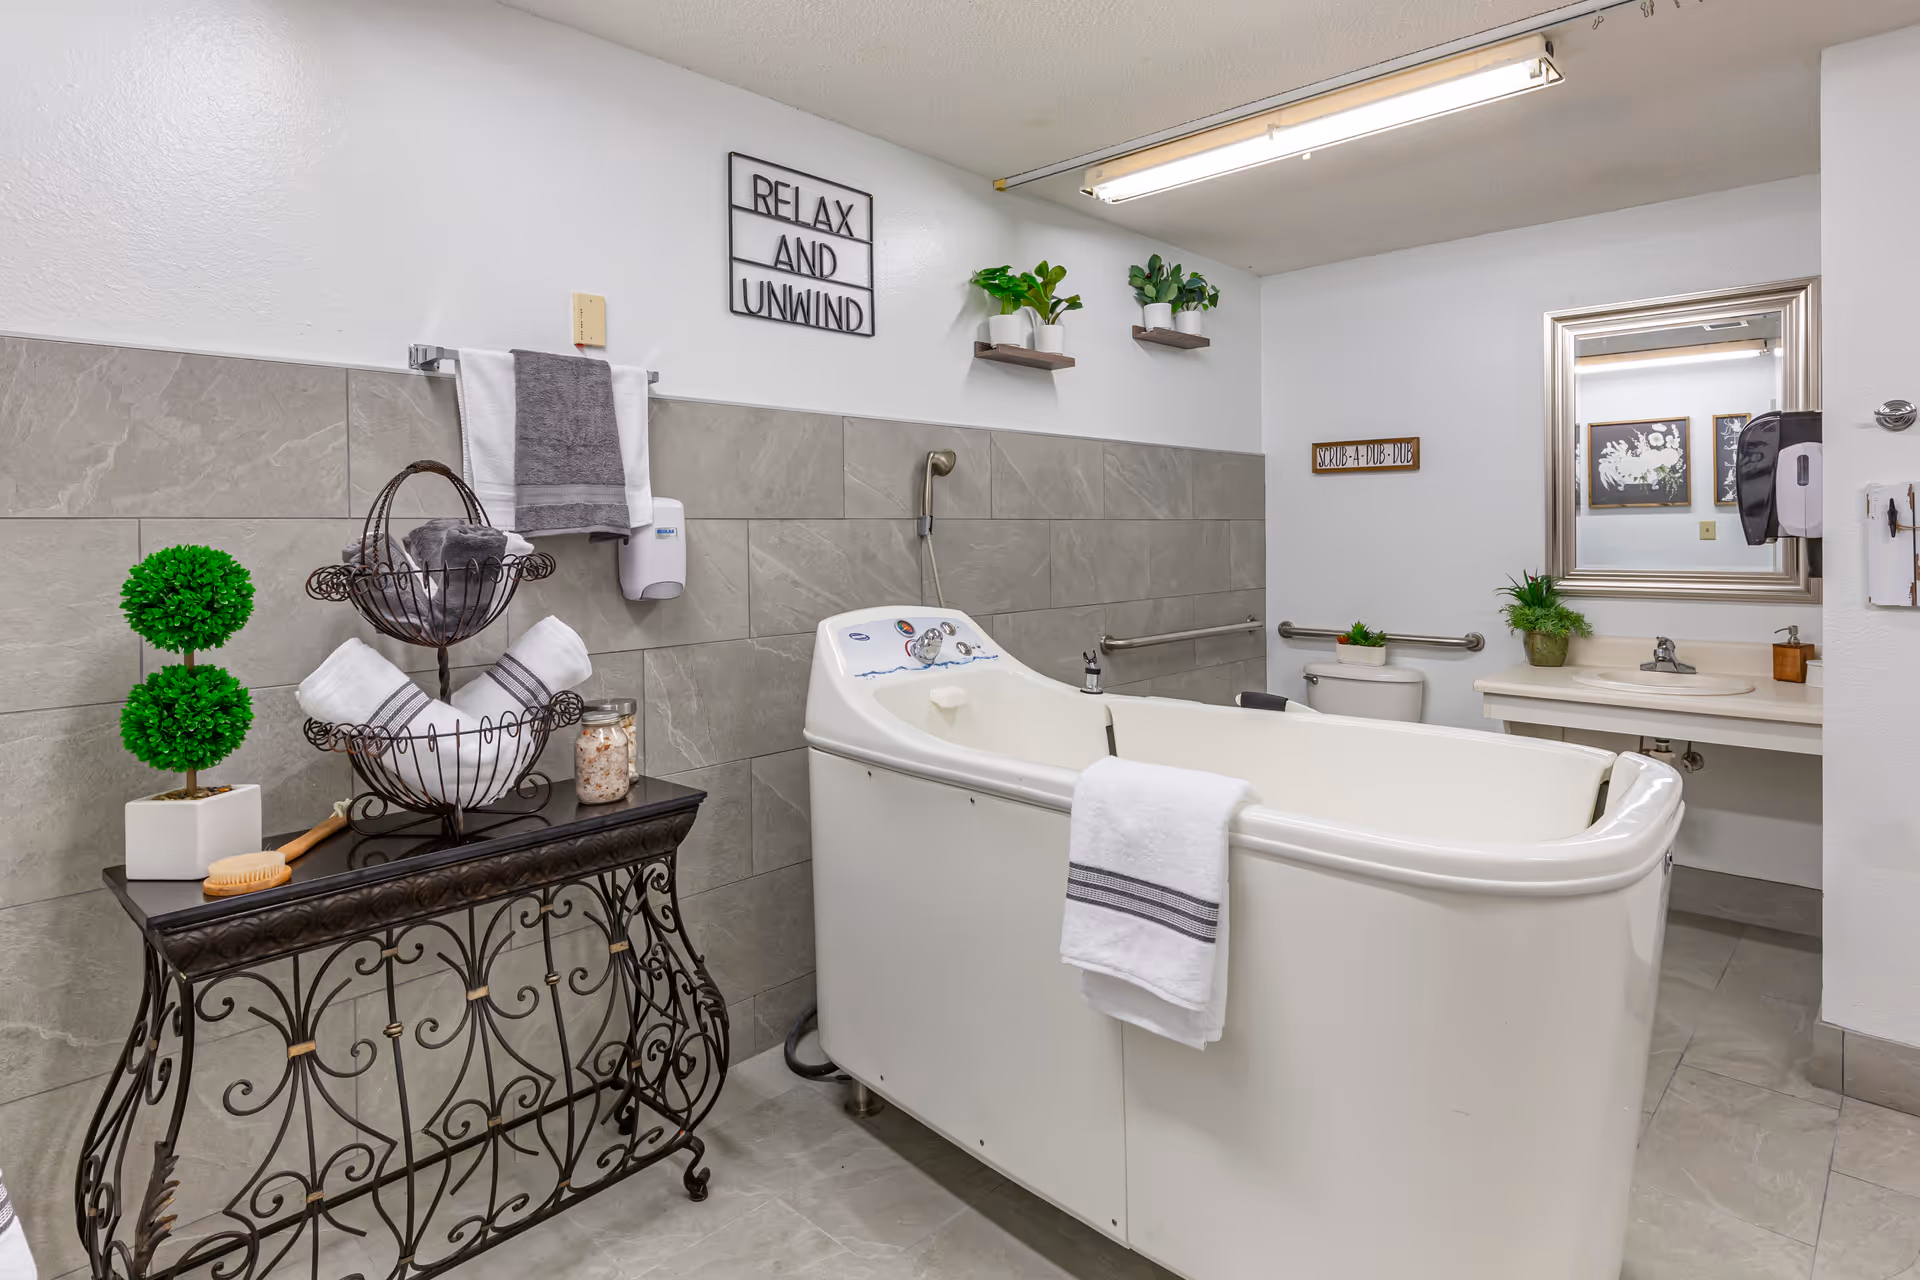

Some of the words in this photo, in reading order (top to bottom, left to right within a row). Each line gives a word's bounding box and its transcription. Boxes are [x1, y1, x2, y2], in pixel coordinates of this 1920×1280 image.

[753, 174, 854, 237] RELAX
[774, 234, 837, 279] AND
[743, 278, 863, 332] UNWIND
